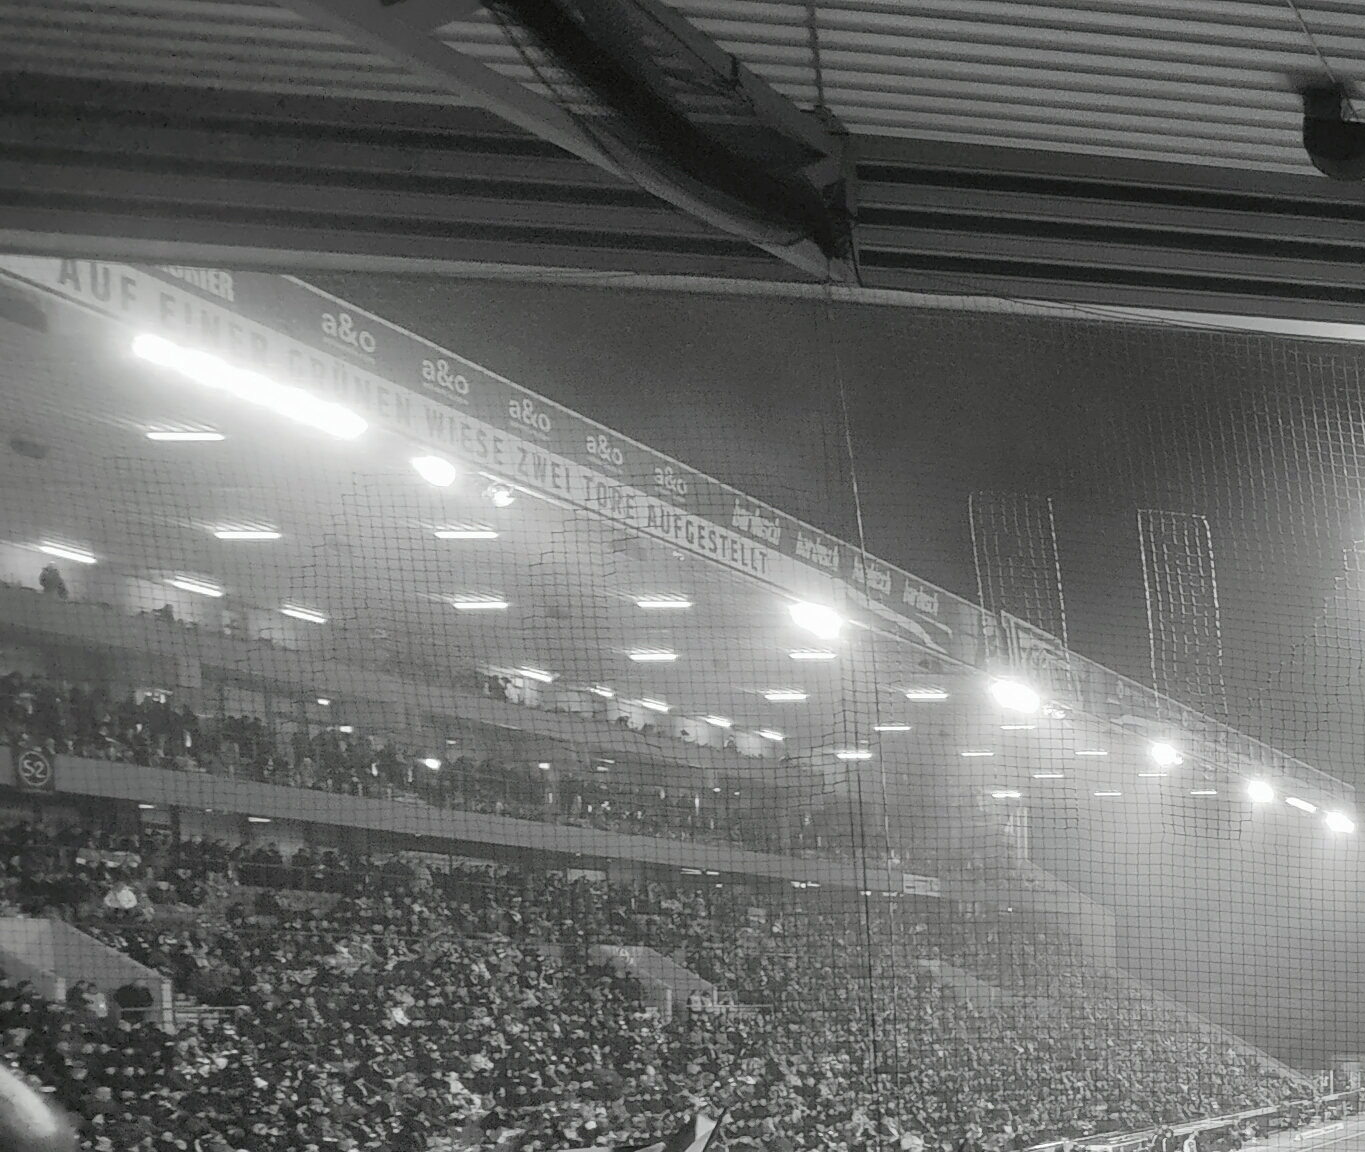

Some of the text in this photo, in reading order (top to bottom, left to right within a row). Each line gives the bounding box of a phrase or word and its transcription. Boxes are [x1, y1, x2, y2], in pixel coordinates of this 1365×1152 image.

[322, 311, 377, 354] a&o
[421, 359, 470, 395] a&o
[56, 259, 136, 311] AUF
[517, 446, 571, 494] ZWEI
[584, 475, 636, 520] TORE
[648, 503, 768, 575] AUFGESTELLT
[508, 398, 551, 433] a&o
[586, 434, 624, 465] a&o
[654, 466, 688, 495] a&o
[23, 759, 46, 779] S2
